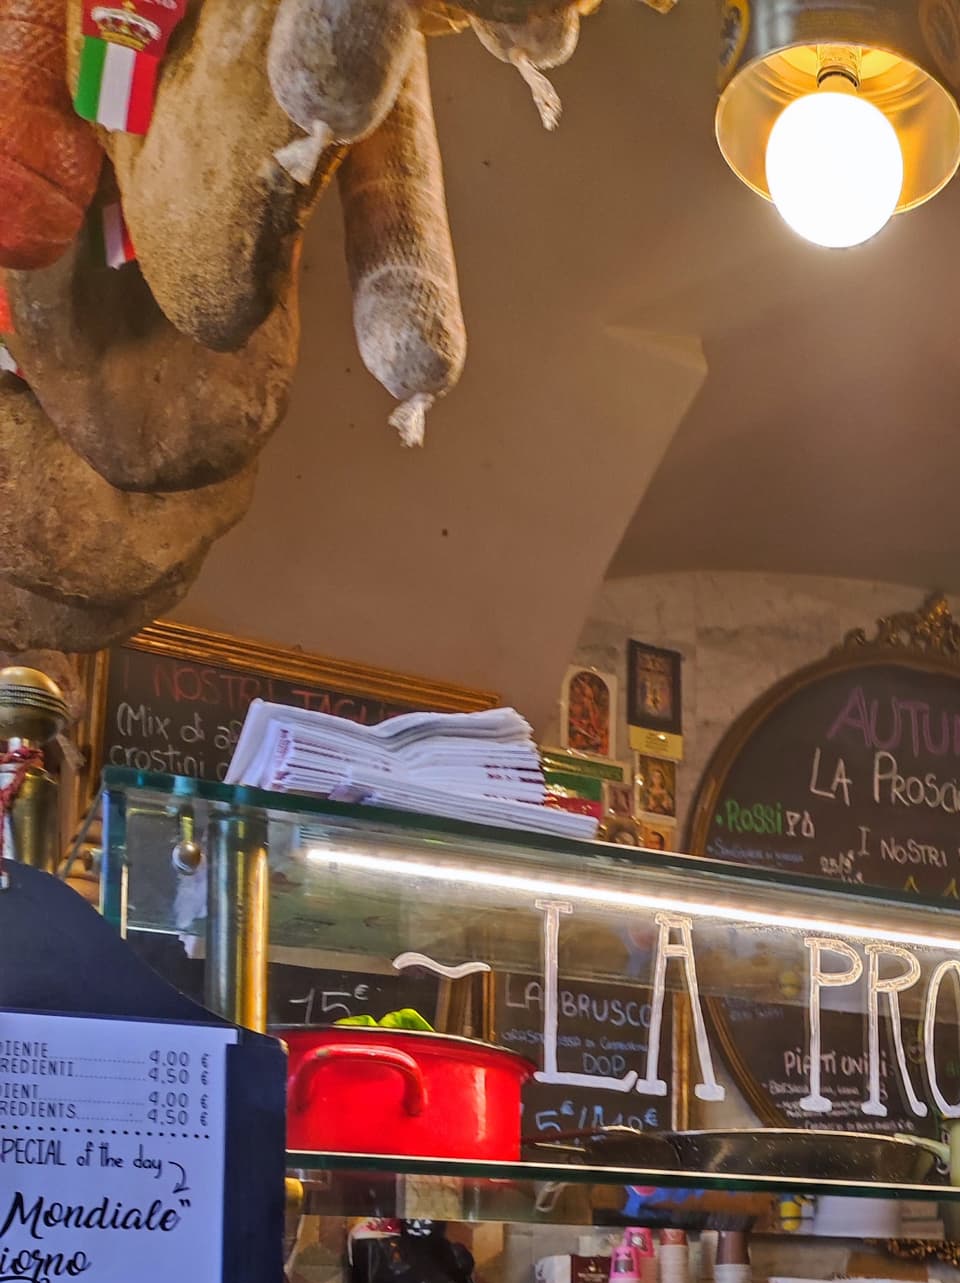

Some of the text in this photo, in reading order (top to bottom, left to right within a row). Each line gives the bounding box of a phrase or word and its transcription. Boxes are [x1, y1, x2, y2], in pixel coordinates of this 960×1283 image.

[810, 747, 853, 807] LA
[857, 825, 871, 857] I
[880, 838, 948, 868] NOSTRI
[505, 973, 653, 1029] LABRUSCO
[532, 899, 726, 1101] LA
[149, 1049, 189, 1067] 4.00
[201, 1053, 209, 1069] €
[582, 1052, 626, 1077] DOP
[148, 1066, 189, 1085] 4.50
[201, 1071, 209, 1086] €
[148, 1091, 189, 1108] 4.00
[200, 1093, 208, 1110] €
[147, 1108, 189, 1126] 4.50
[200, 1112, 208, 1127] €
[76, 1141, 94, 1167] of
[99, 1142, 123, 1168] the
[133, 1143, 162, 1179] day
